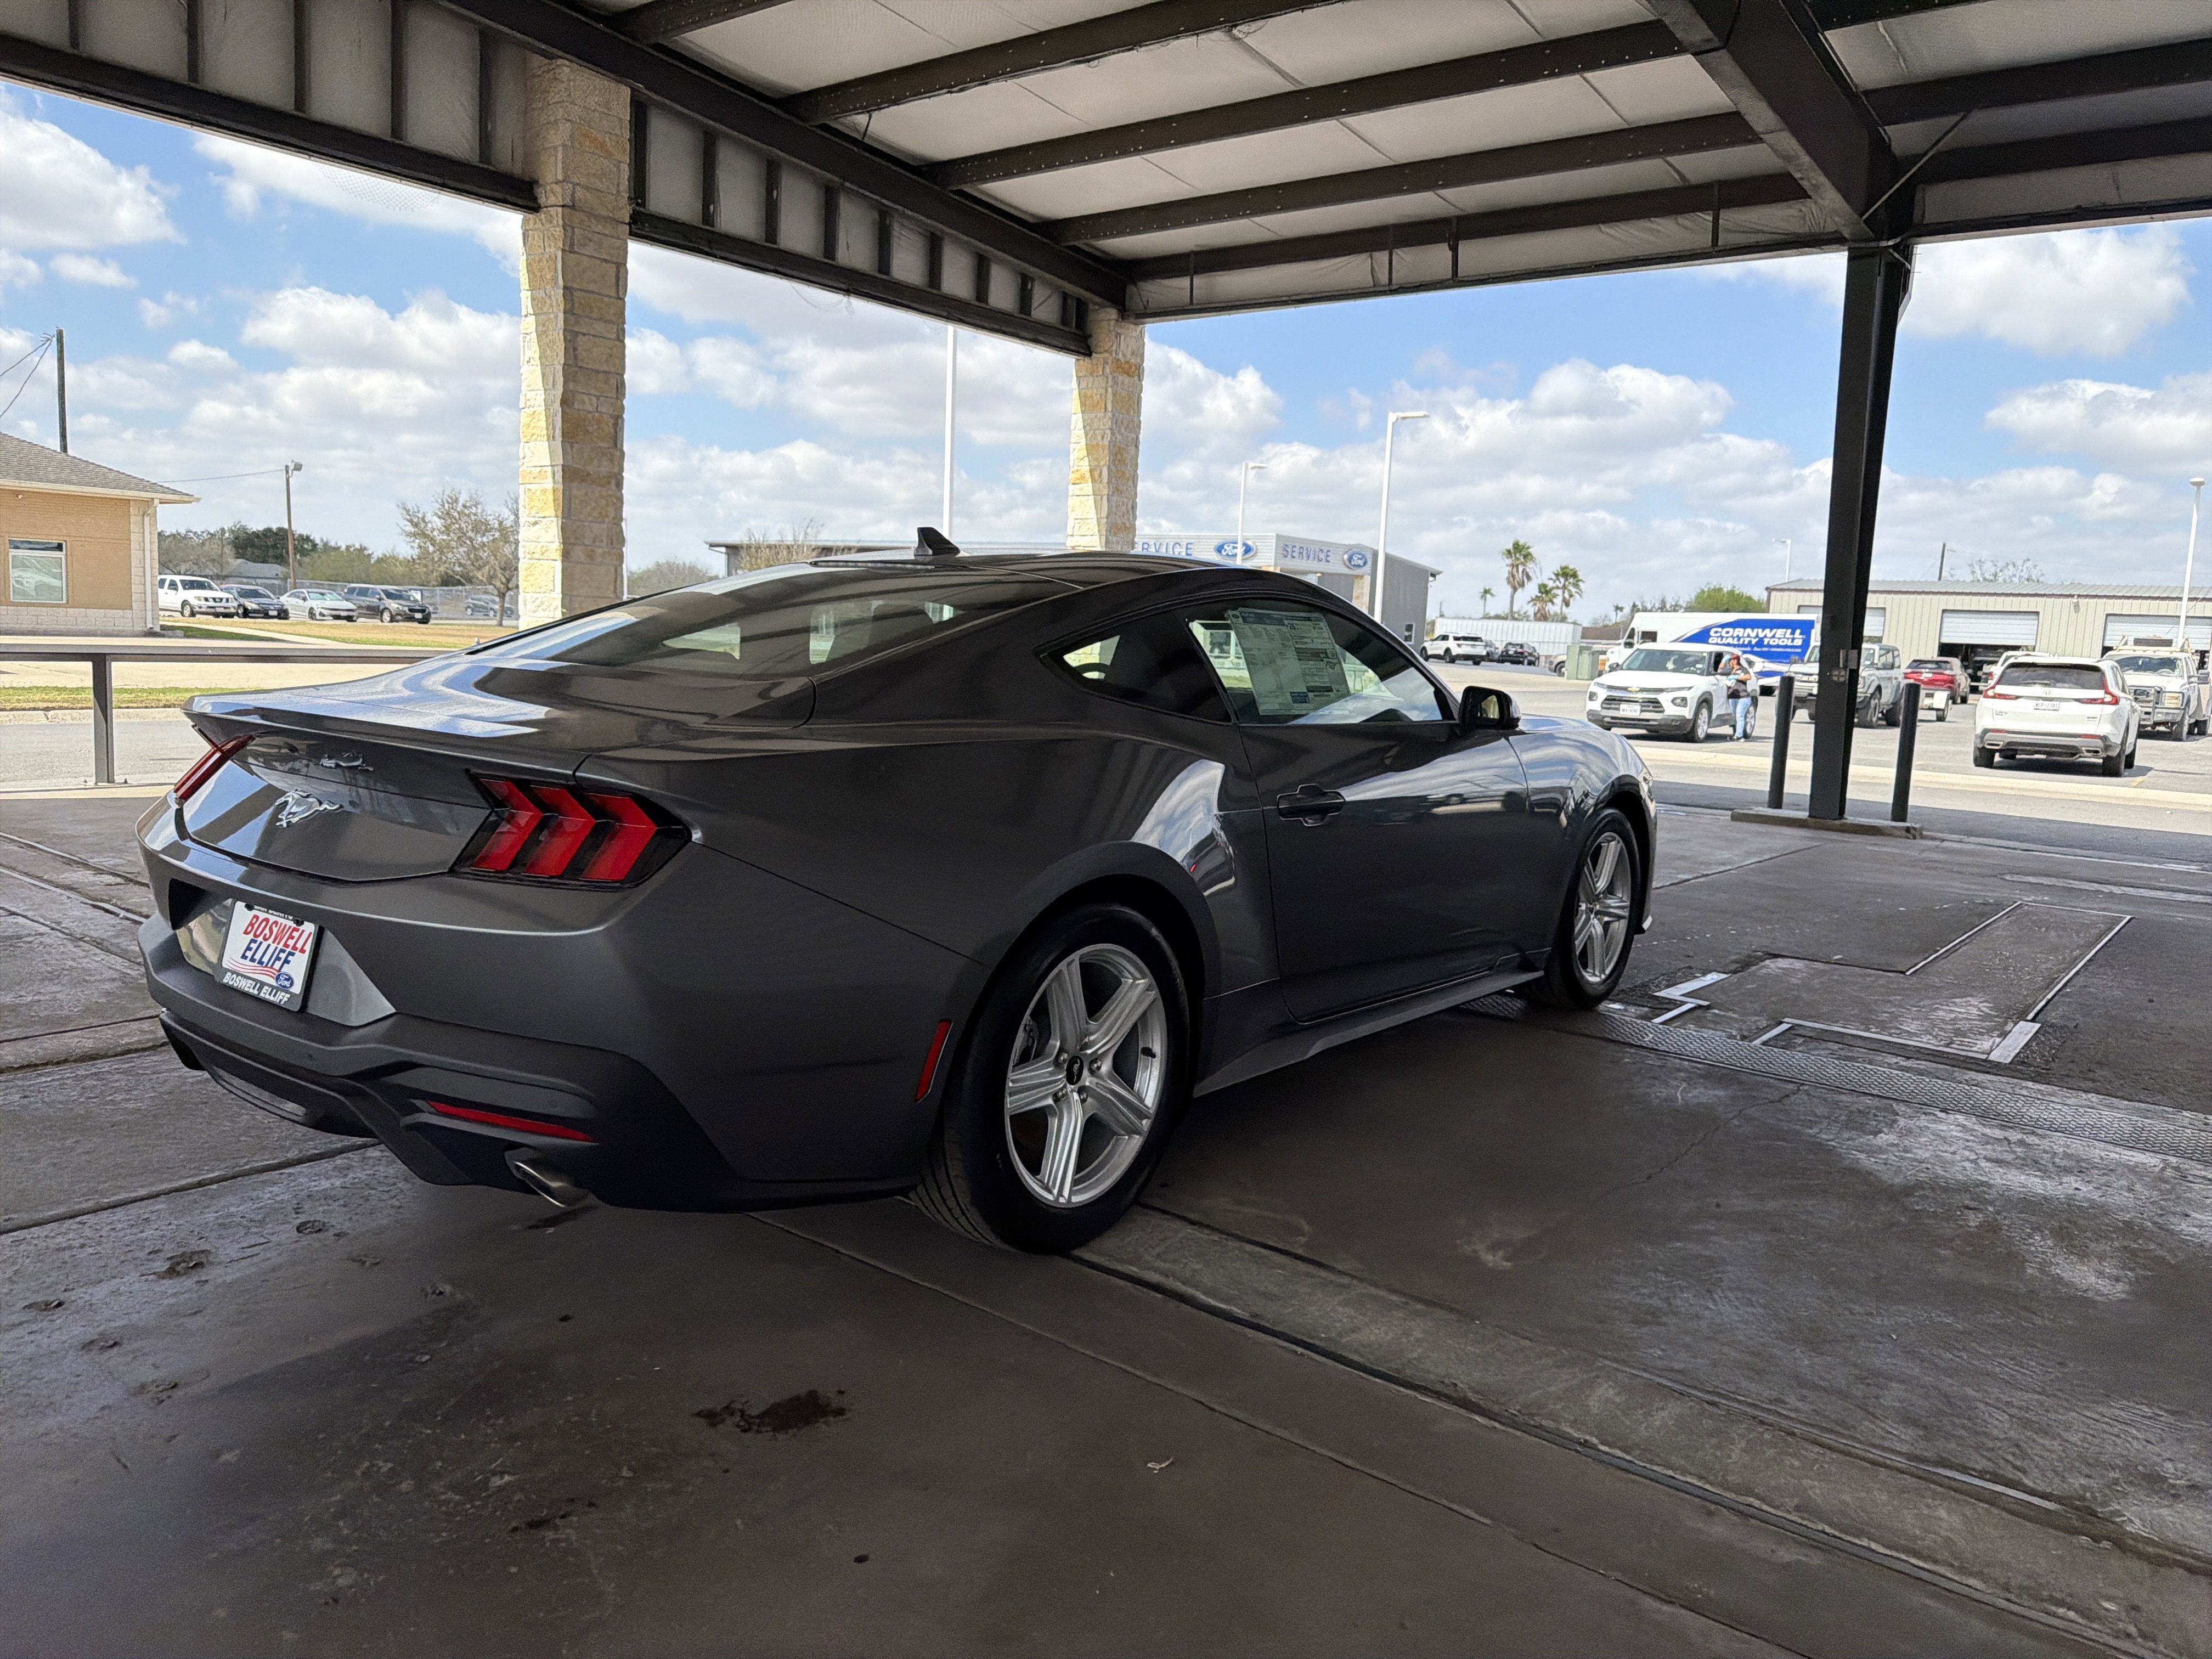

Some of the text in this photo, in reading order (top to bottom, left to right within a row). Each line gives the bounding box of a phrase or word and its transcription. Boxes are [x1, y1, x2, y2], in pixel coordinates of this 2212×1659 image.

[1135, 541, 1194, 556] RVICE
[1283, 544, 1365, 566] SERVICE Ford
[1709, 628, 1803, 638] CORNWELL
[242, 914, 312, 954] BOSWELL
[240, 938, 296, 972] ELLIFF
[223, 972, 260, 994] BOSWELL
[278, 974, 291, 987] Ford
[259, 986, 290, 1005] ELLIFF
